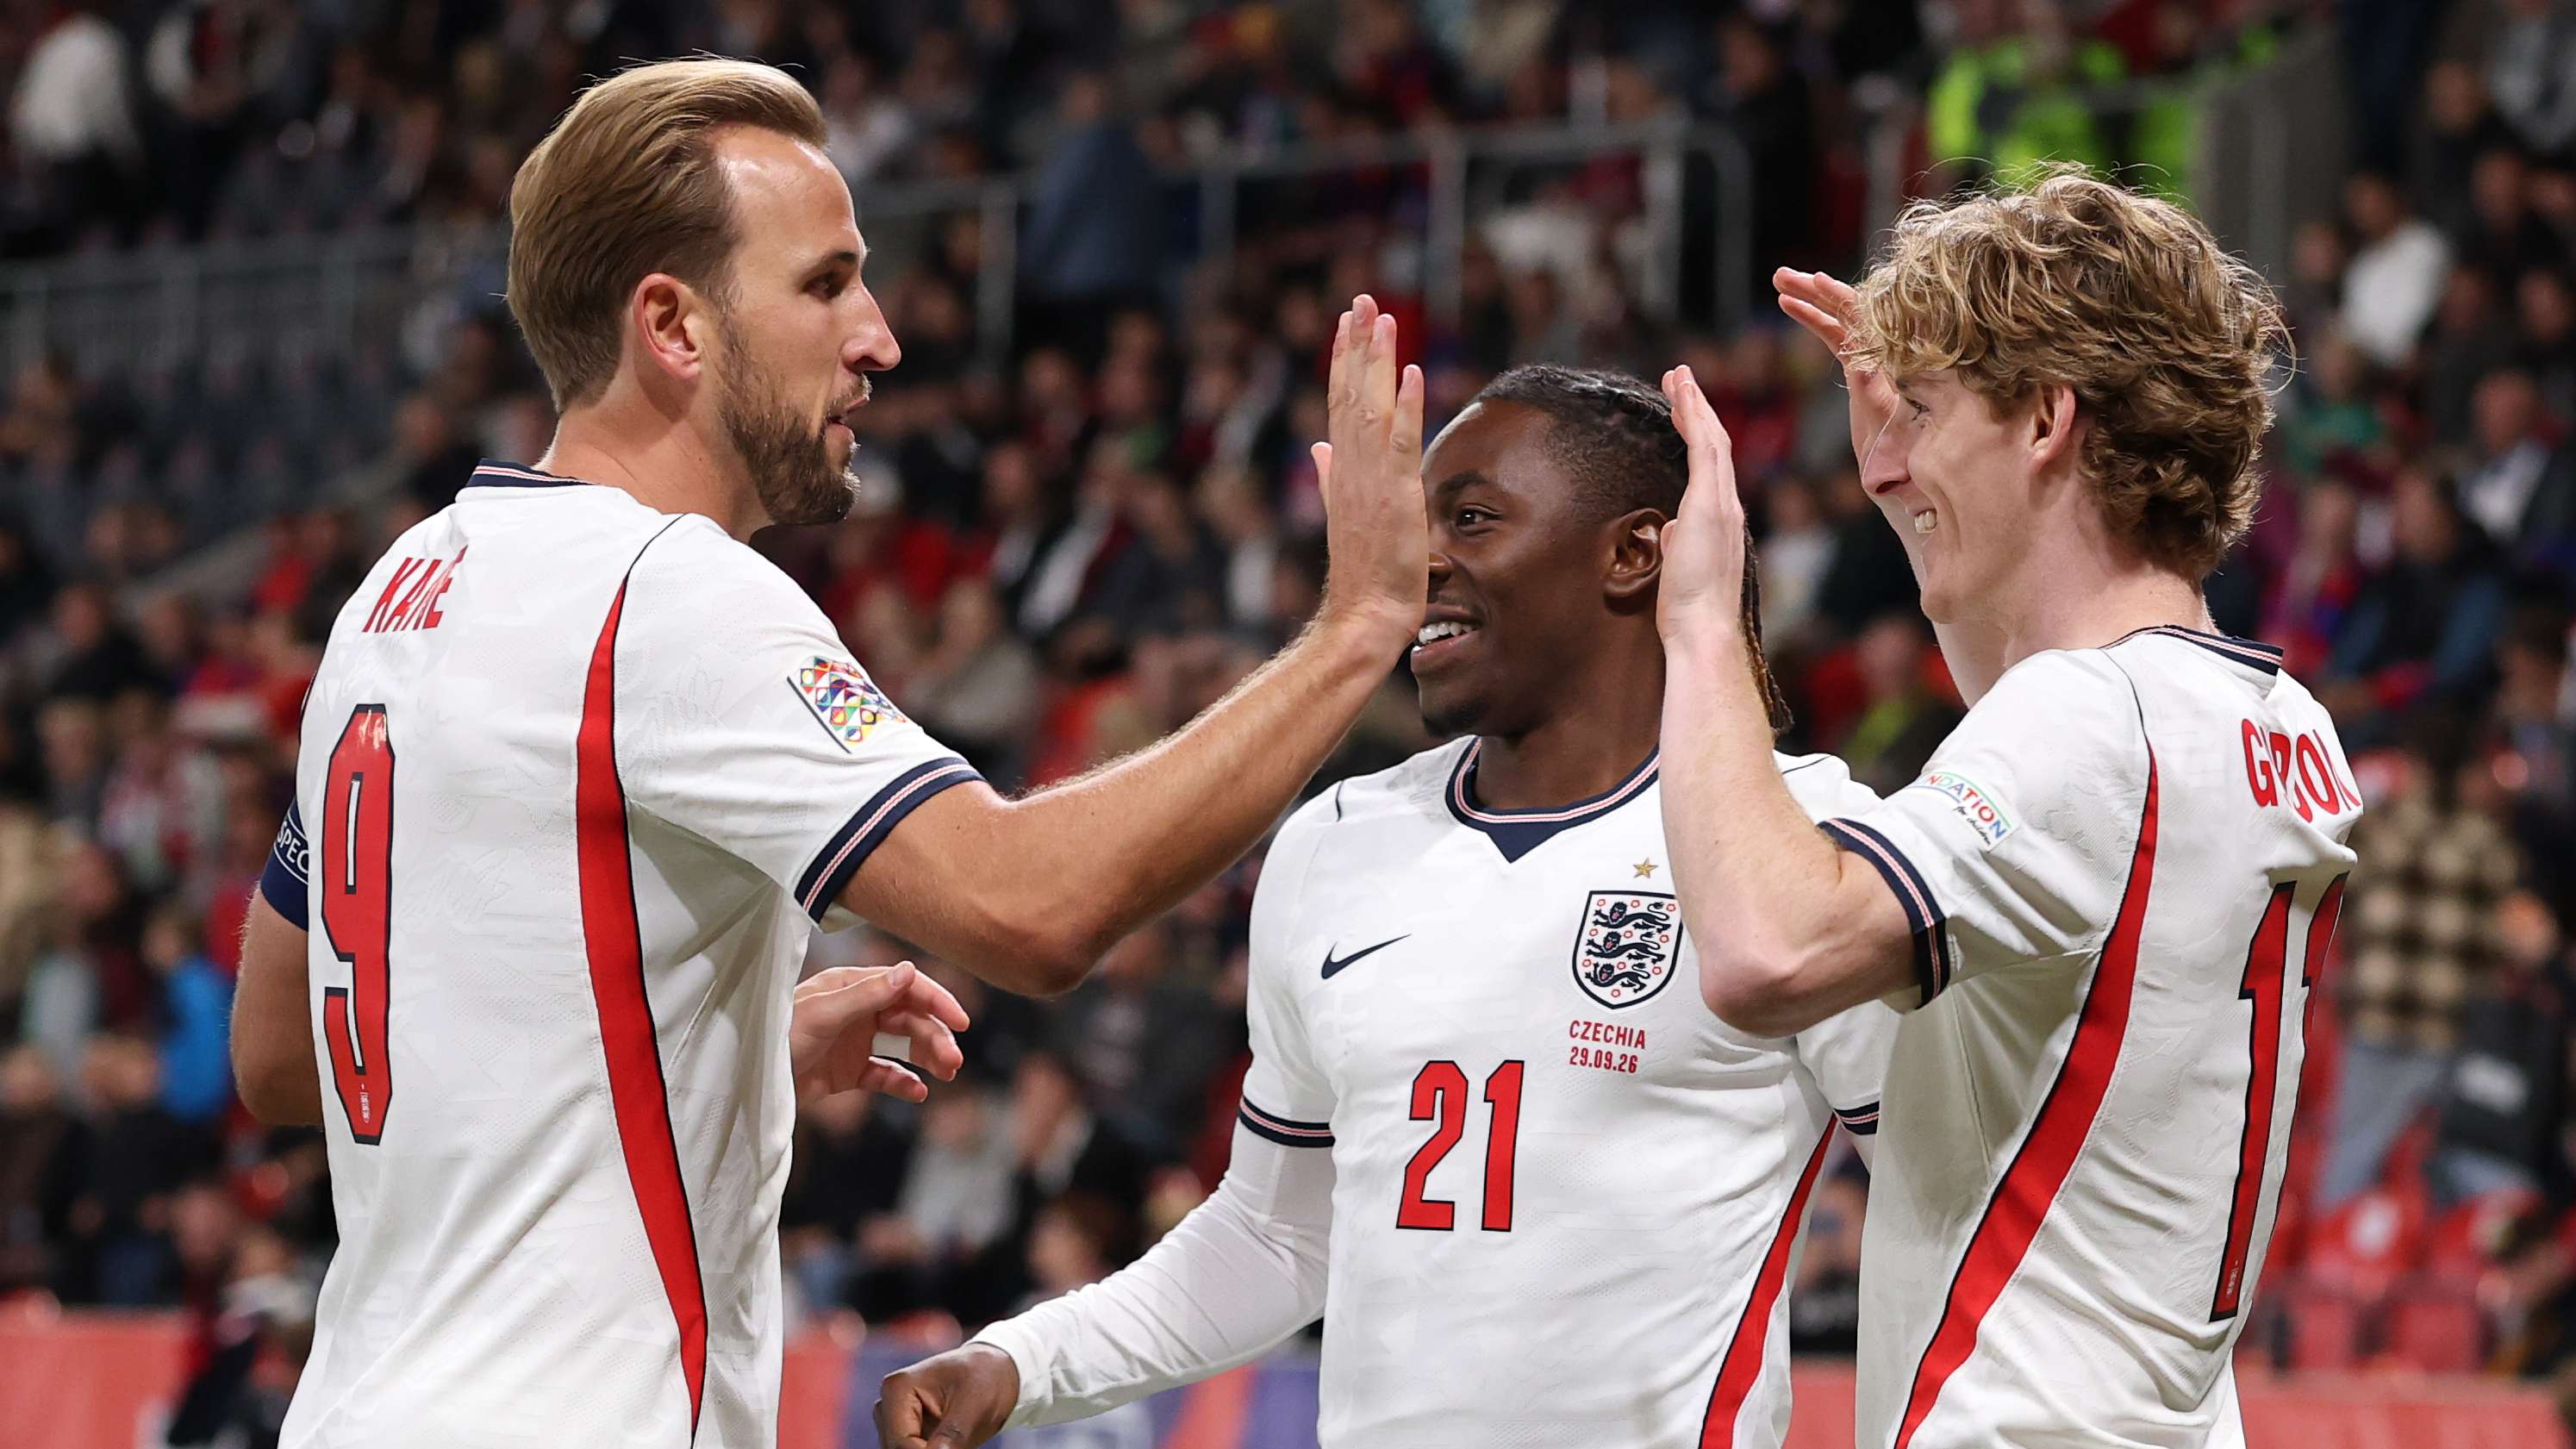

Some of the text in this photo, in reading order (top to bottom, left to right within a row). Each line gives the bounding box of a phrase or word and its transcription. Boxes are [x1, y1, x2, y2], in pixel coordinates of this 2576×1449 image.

[1915, 774, 2007, 839] NDATION
[2241, 718, 2361, 823] GRON
[321, 703, 395, 1146] 9
[1569, 1020, 1646, 1050] CZECHIA
[1569, 1046, 1638, 1073] 29.09.26
[1395, 1059, 1525, 1232] 21
